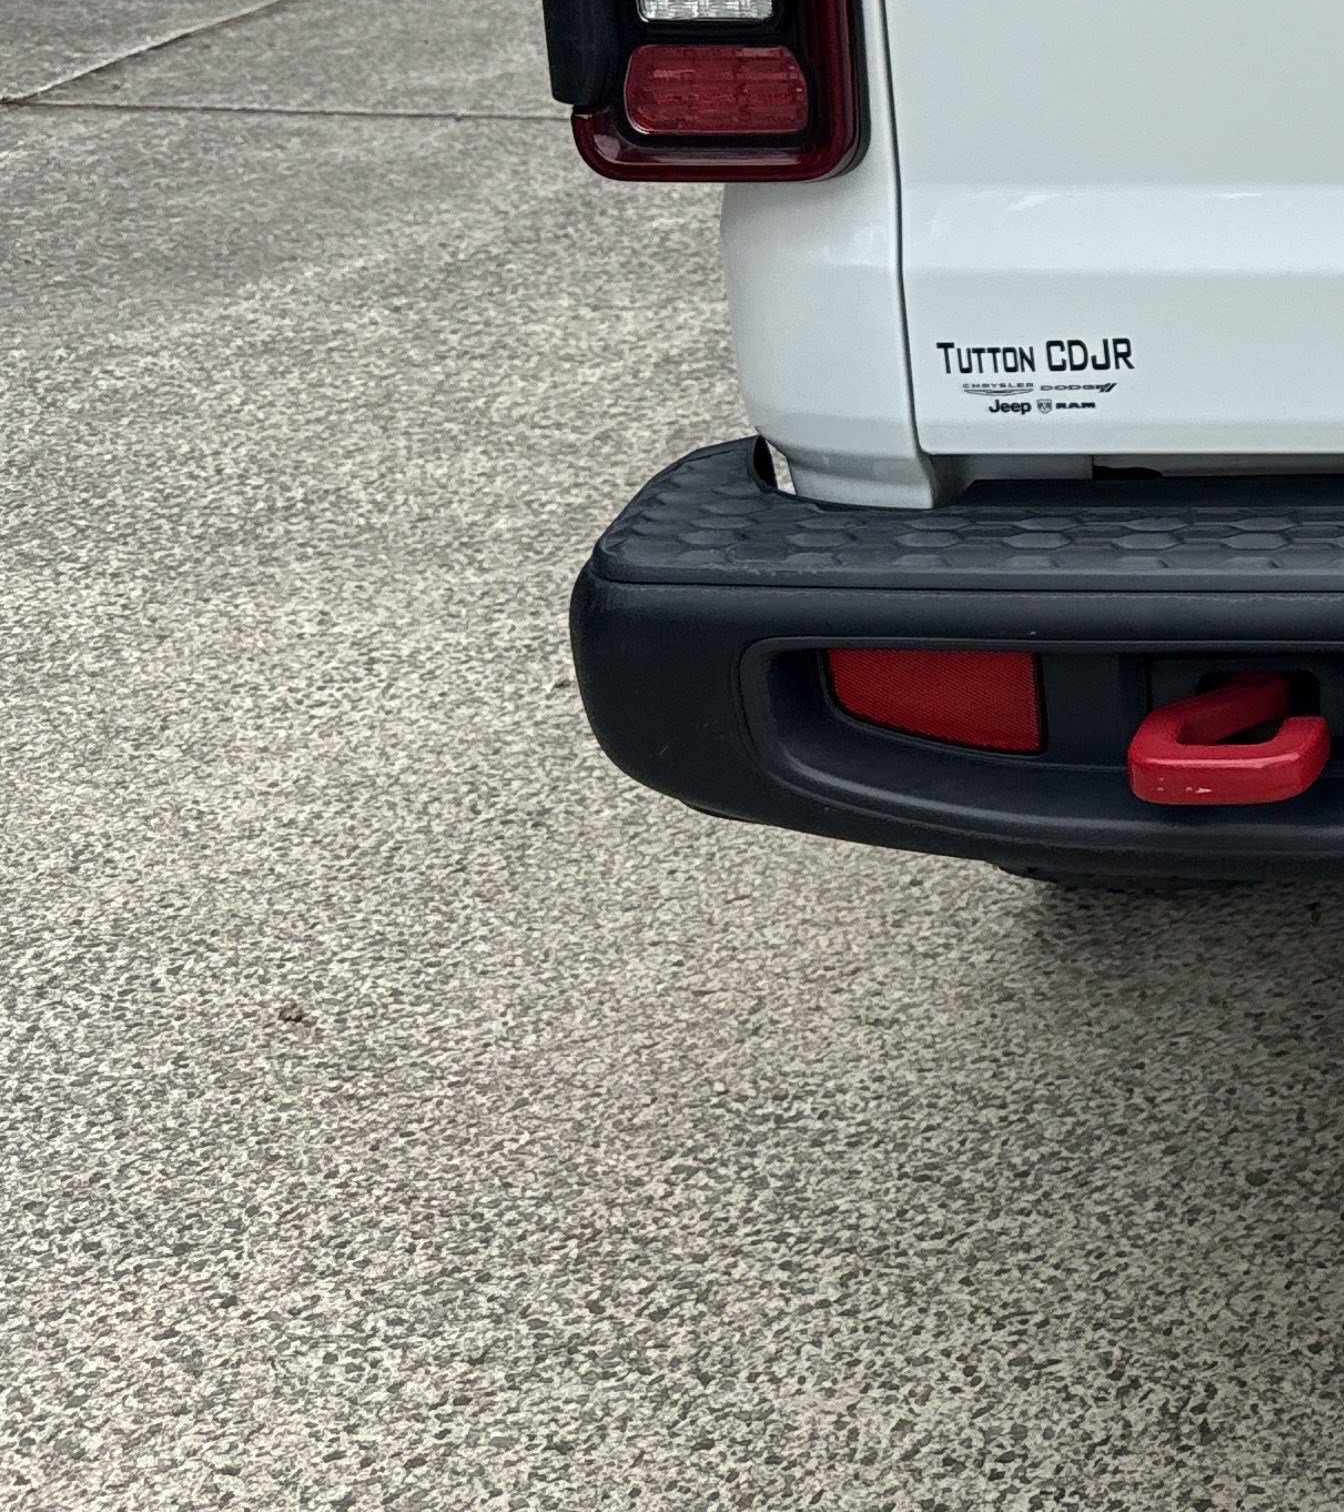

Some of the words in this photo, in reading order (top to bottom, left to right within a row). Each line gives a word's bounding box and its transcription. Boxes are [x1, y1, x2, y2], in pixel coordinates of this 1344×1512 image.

[1045, 338, 1135, 372] CDJR
[988, 399, 1032, 415] Jeep
[1055, 401, 1096, 410] RAM
